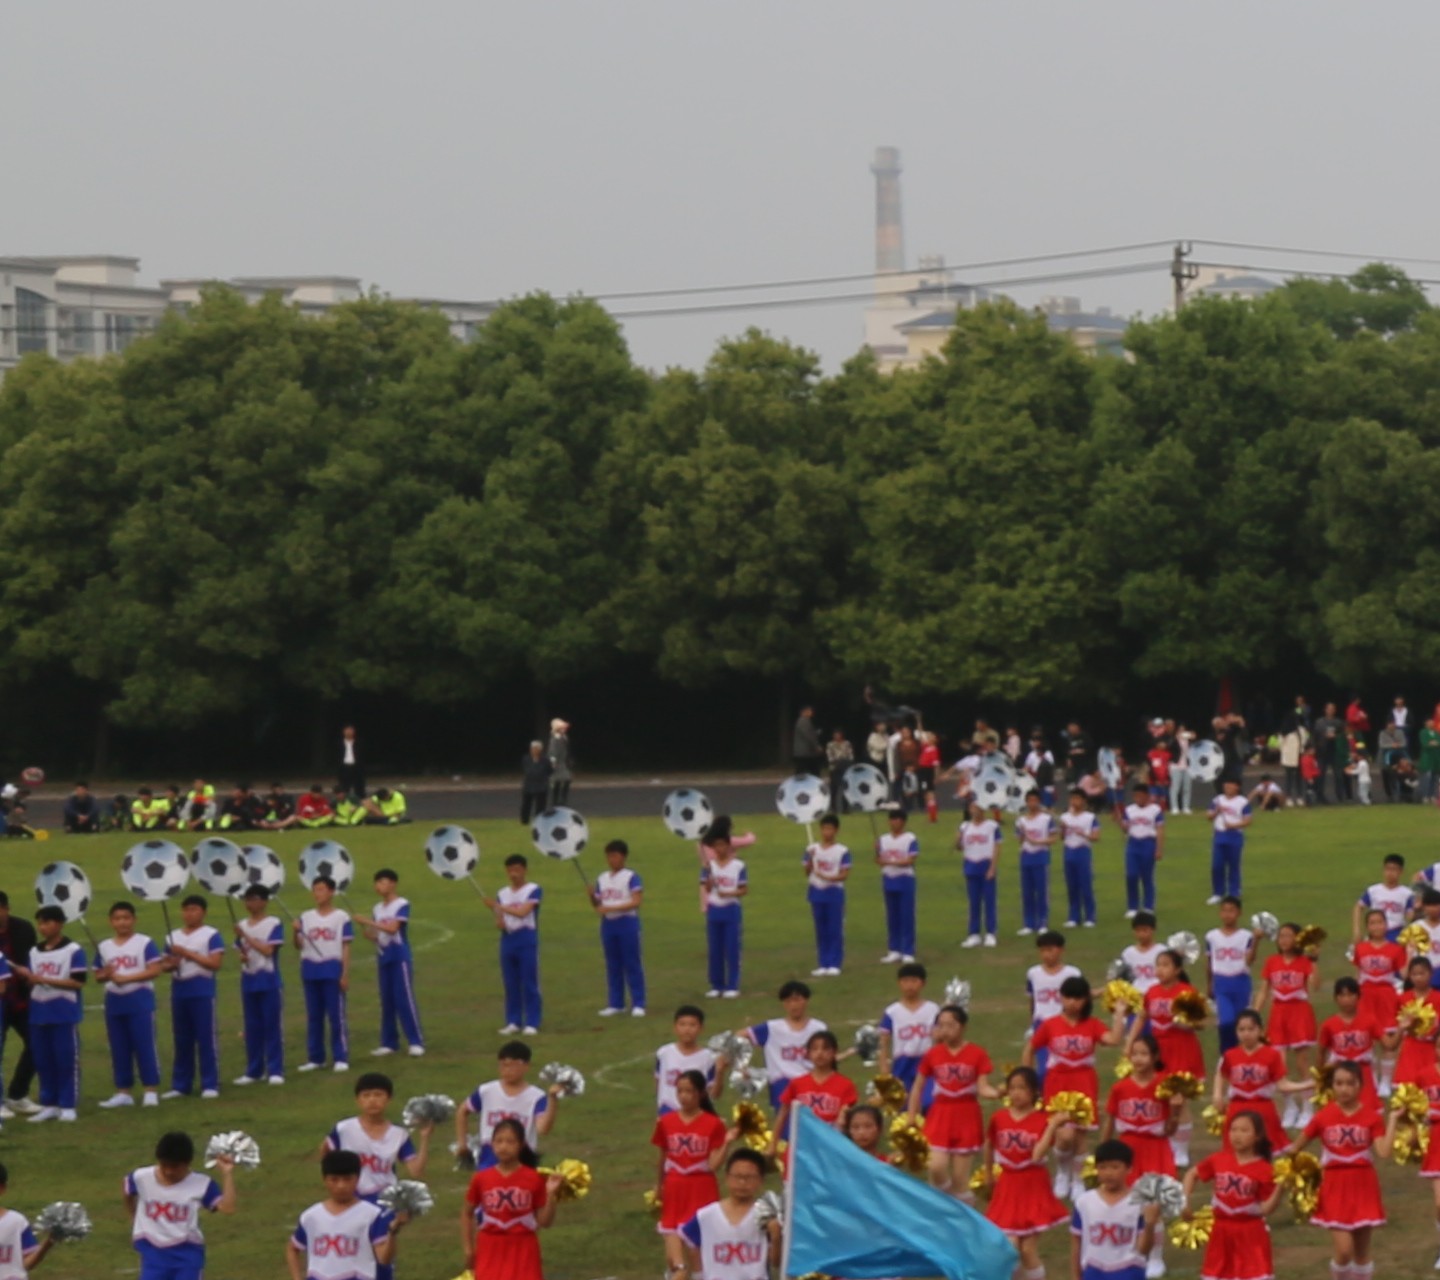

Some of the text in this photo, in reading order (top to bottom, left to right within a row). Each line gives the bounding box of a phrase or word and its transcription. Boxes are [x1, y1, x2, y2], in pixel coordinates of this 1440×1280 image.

[1323, 1127, 1370, 1148] CXU
[483, 1187, 531, 1209] CXU
[144, 1202, 189, 1221] CXU
[313, 1235, 359, 1256] CXU
[1088, 1224, 1134, 1246] CXU
[714, 1242, 761, 1265] CXU
